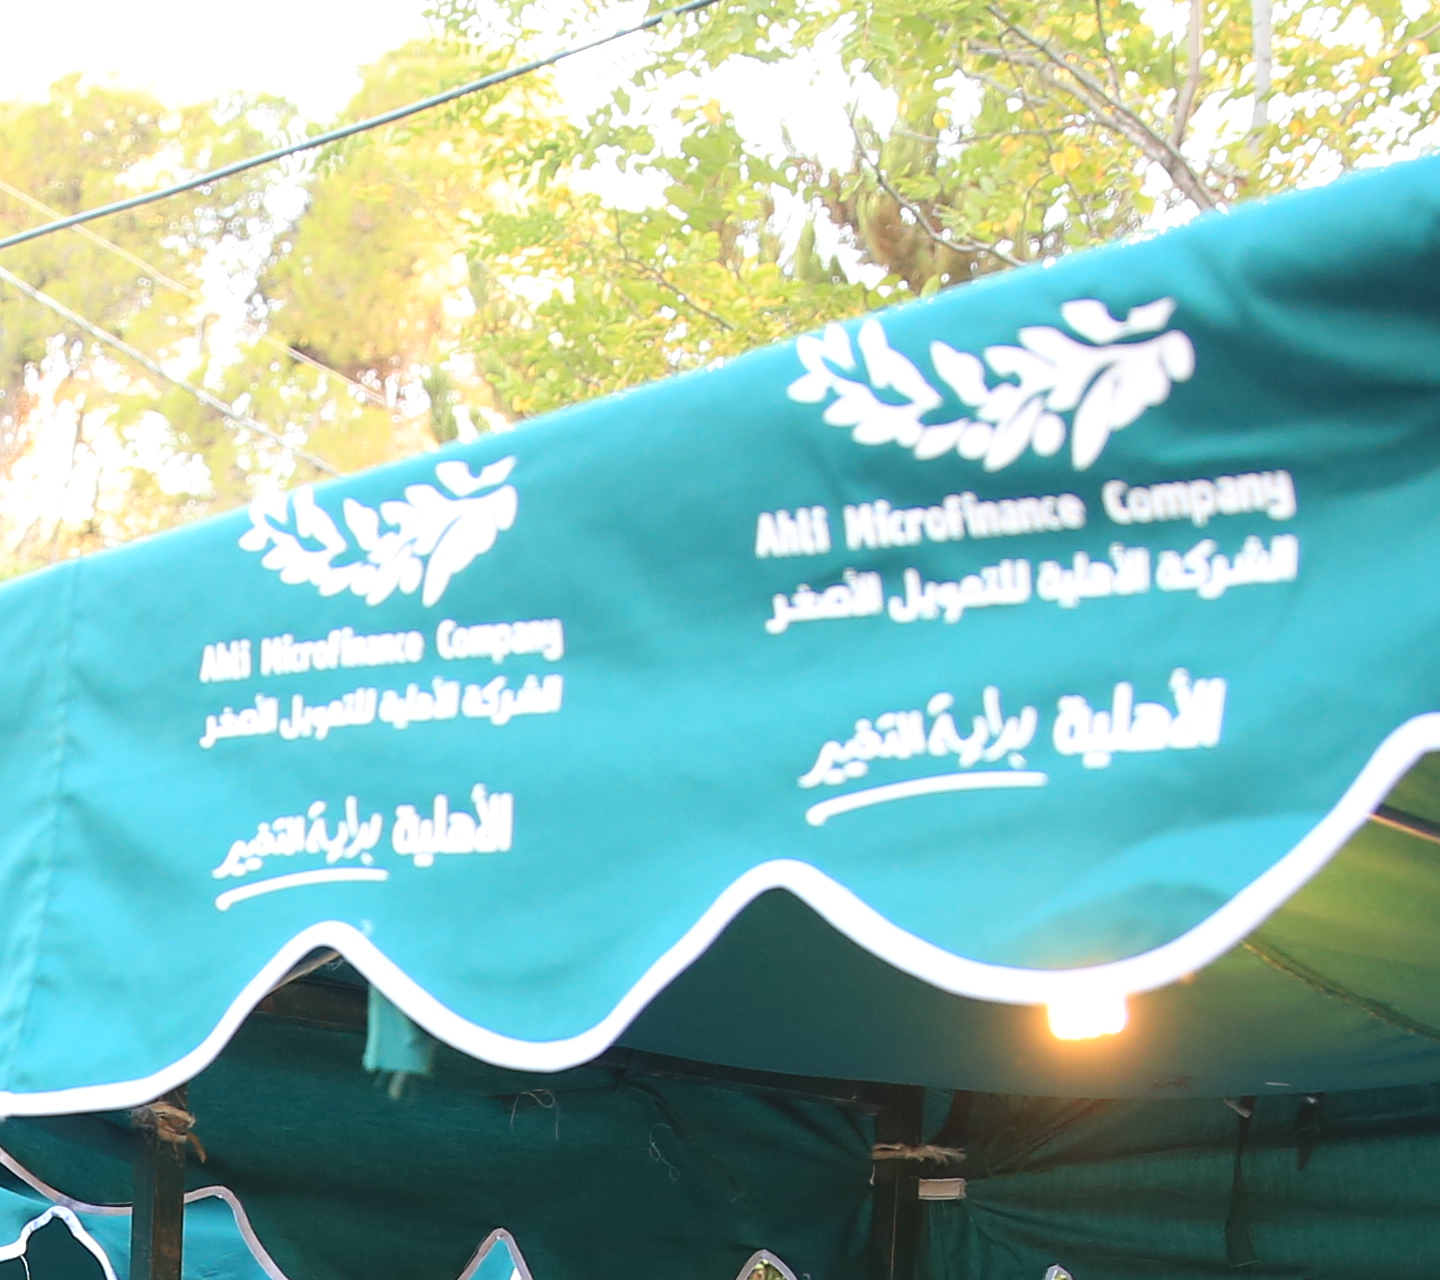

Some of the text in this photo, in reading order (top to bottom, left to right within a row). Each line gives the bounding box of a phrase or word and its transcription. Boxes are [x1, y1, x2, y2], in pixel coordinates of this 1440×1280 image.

[756, 471, 1296, 557] Ahli Microfinance Company
[765, 535, 1298, 633] الشركة الأهلية للتمويل الأصغر
[200, 619, 563, 682] Ahli Microfinance Company
[1053, 668, 1226, 768] الأهلية
[392, 784, 513, 867] الأهلية
